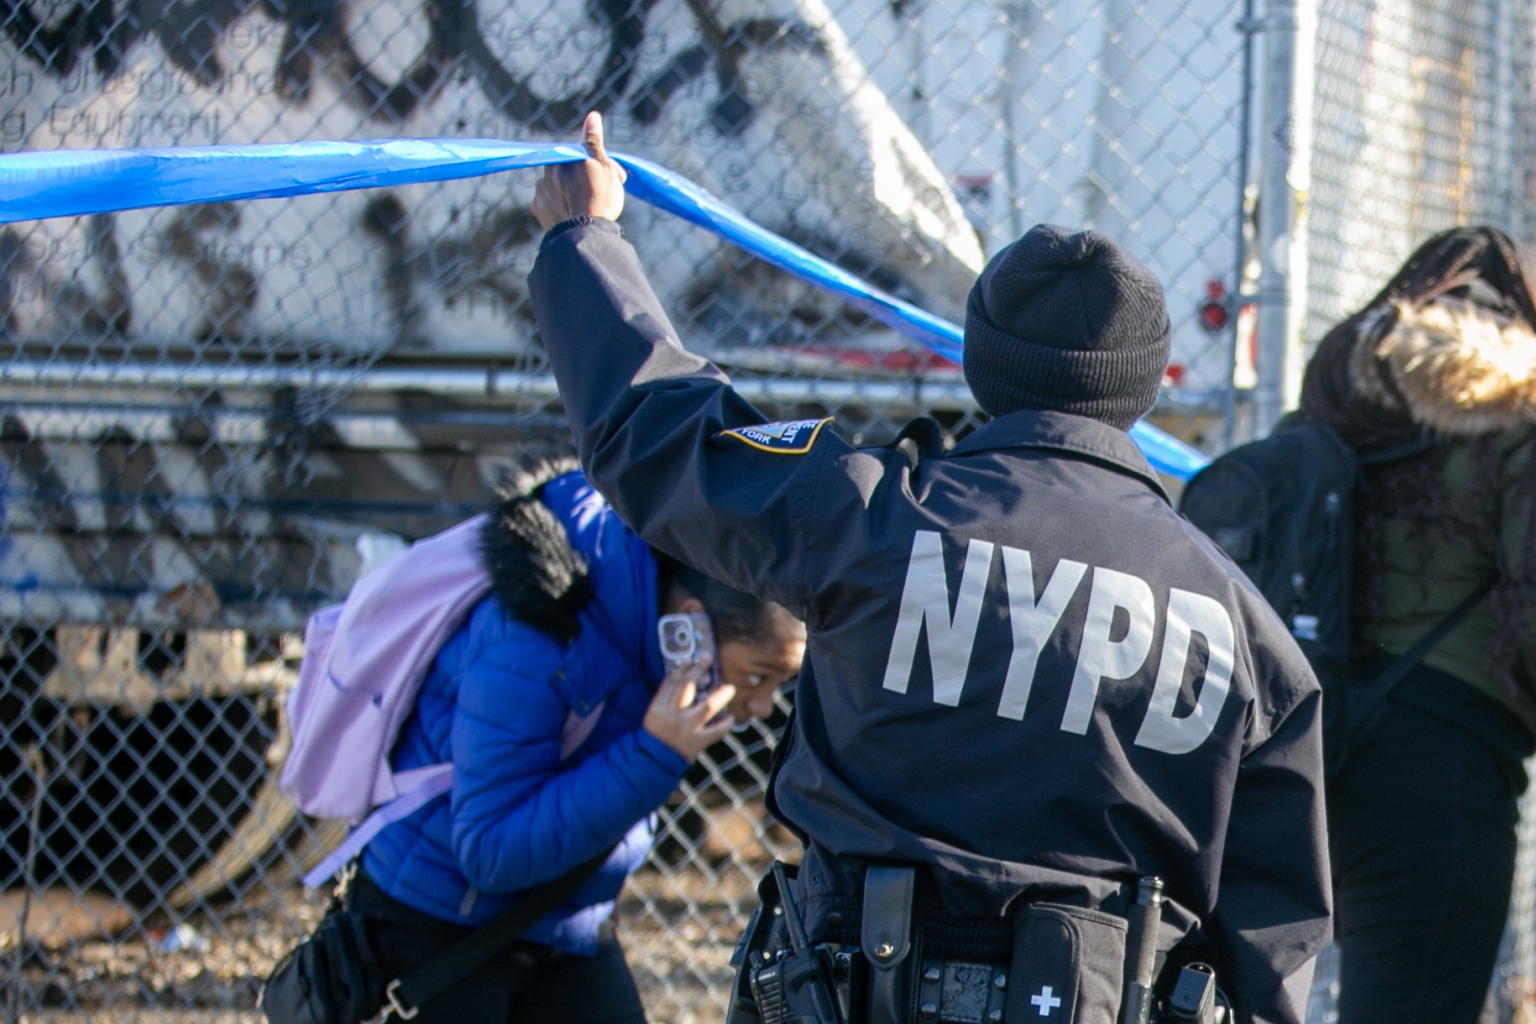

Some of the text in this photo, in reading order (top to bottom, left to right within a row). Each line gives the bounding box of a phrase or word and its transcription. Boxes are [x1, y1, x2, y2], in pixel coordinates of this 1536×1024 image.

[50, 102, 221, 142] Equipment
[741, 429, 772, 445] YORK
[883, 529, 1235, 756] NYPD
